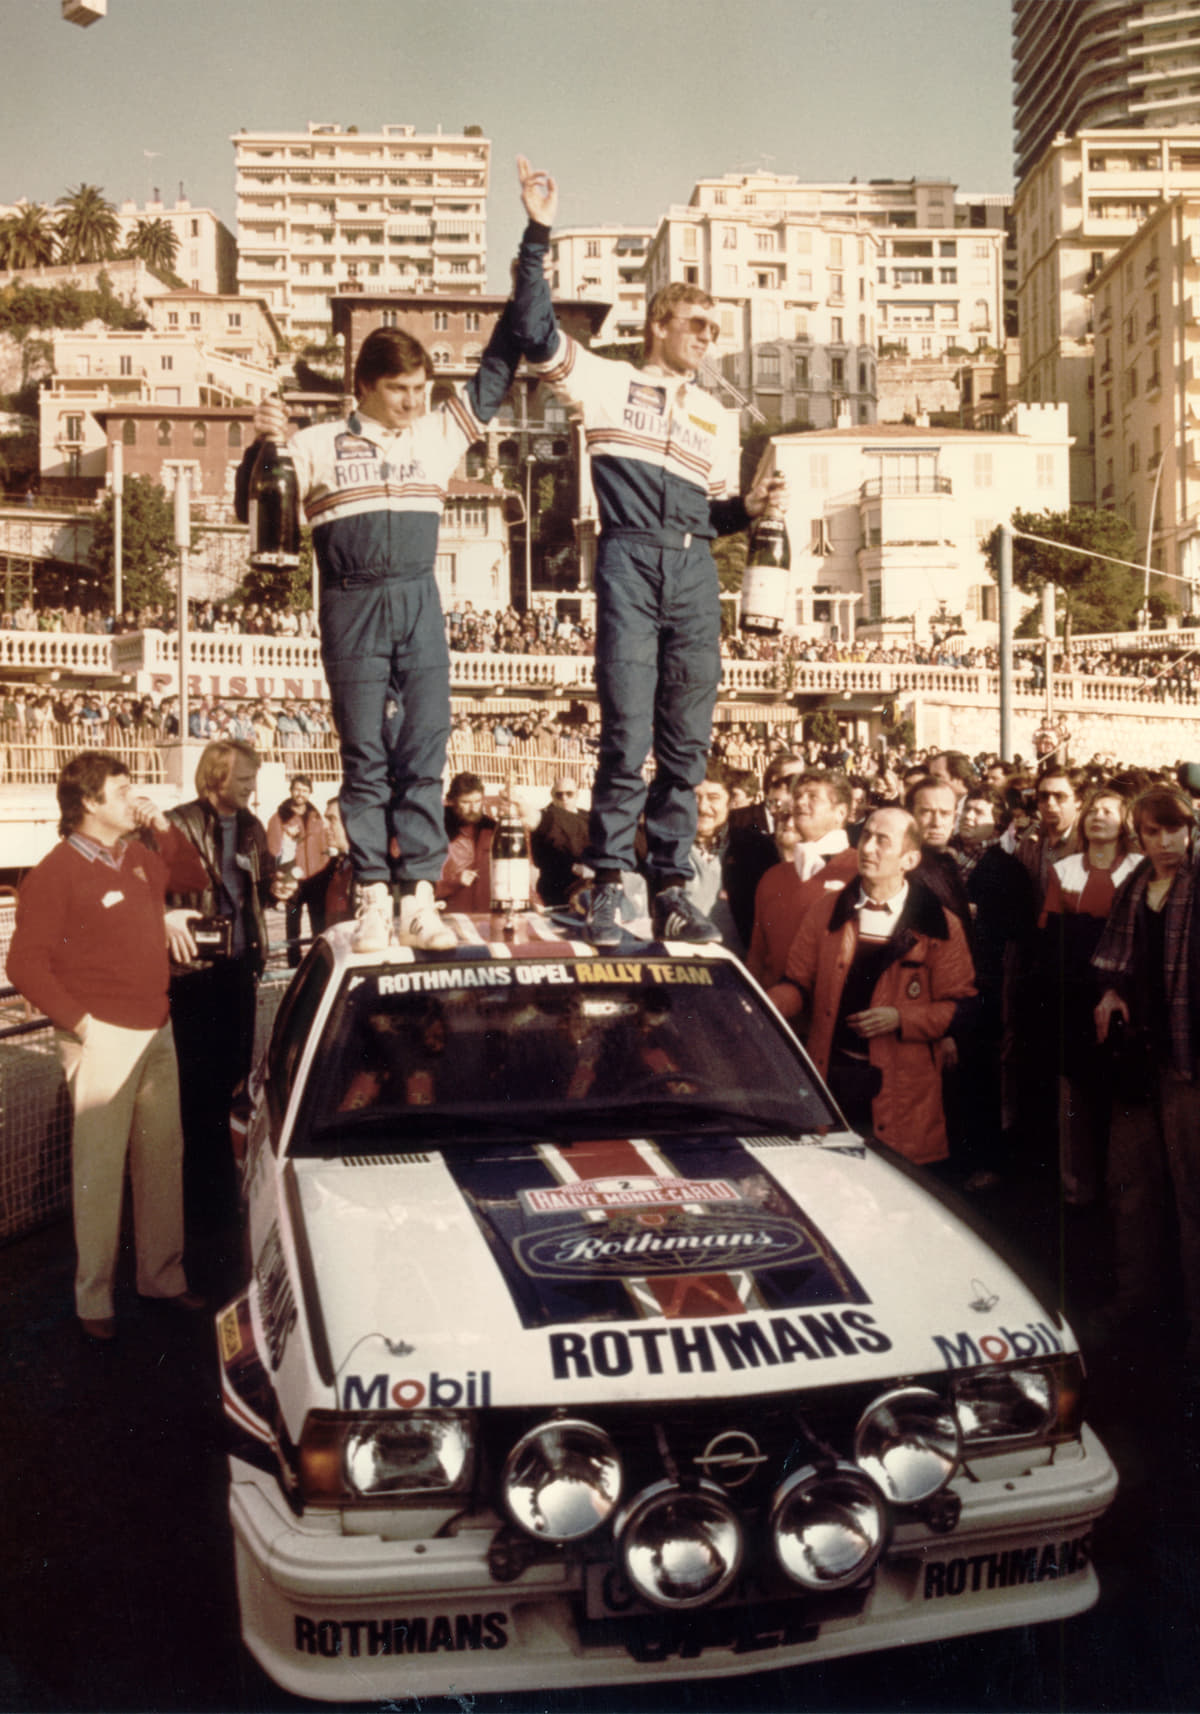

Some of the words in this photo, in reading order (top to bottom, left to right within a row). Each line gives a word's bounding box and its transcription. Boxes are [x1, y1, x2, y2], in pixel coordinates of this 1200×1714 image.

[378, 966, 512, 995] ROTHMANS
[515, 964, 574, 985] OPEL
[575, 963, 643, 984] RALLY
[647, 964, 713, 985] TEAM
[537, 1191, 599, 1208] RALLYE
[618, 1181, 632, 1190] 2
[555, 1231, 788, 1262] Rothmans
[548, 1310, 893, 1379] ROTHMANS
[931, 1322, 1061, 1369] Mobil
[343, 1371, 491, 1409] Mobil
[923, 1536, 1092, 1600] ROTHMANS
[294, 1612, 509, 1657] ROTHMANS
